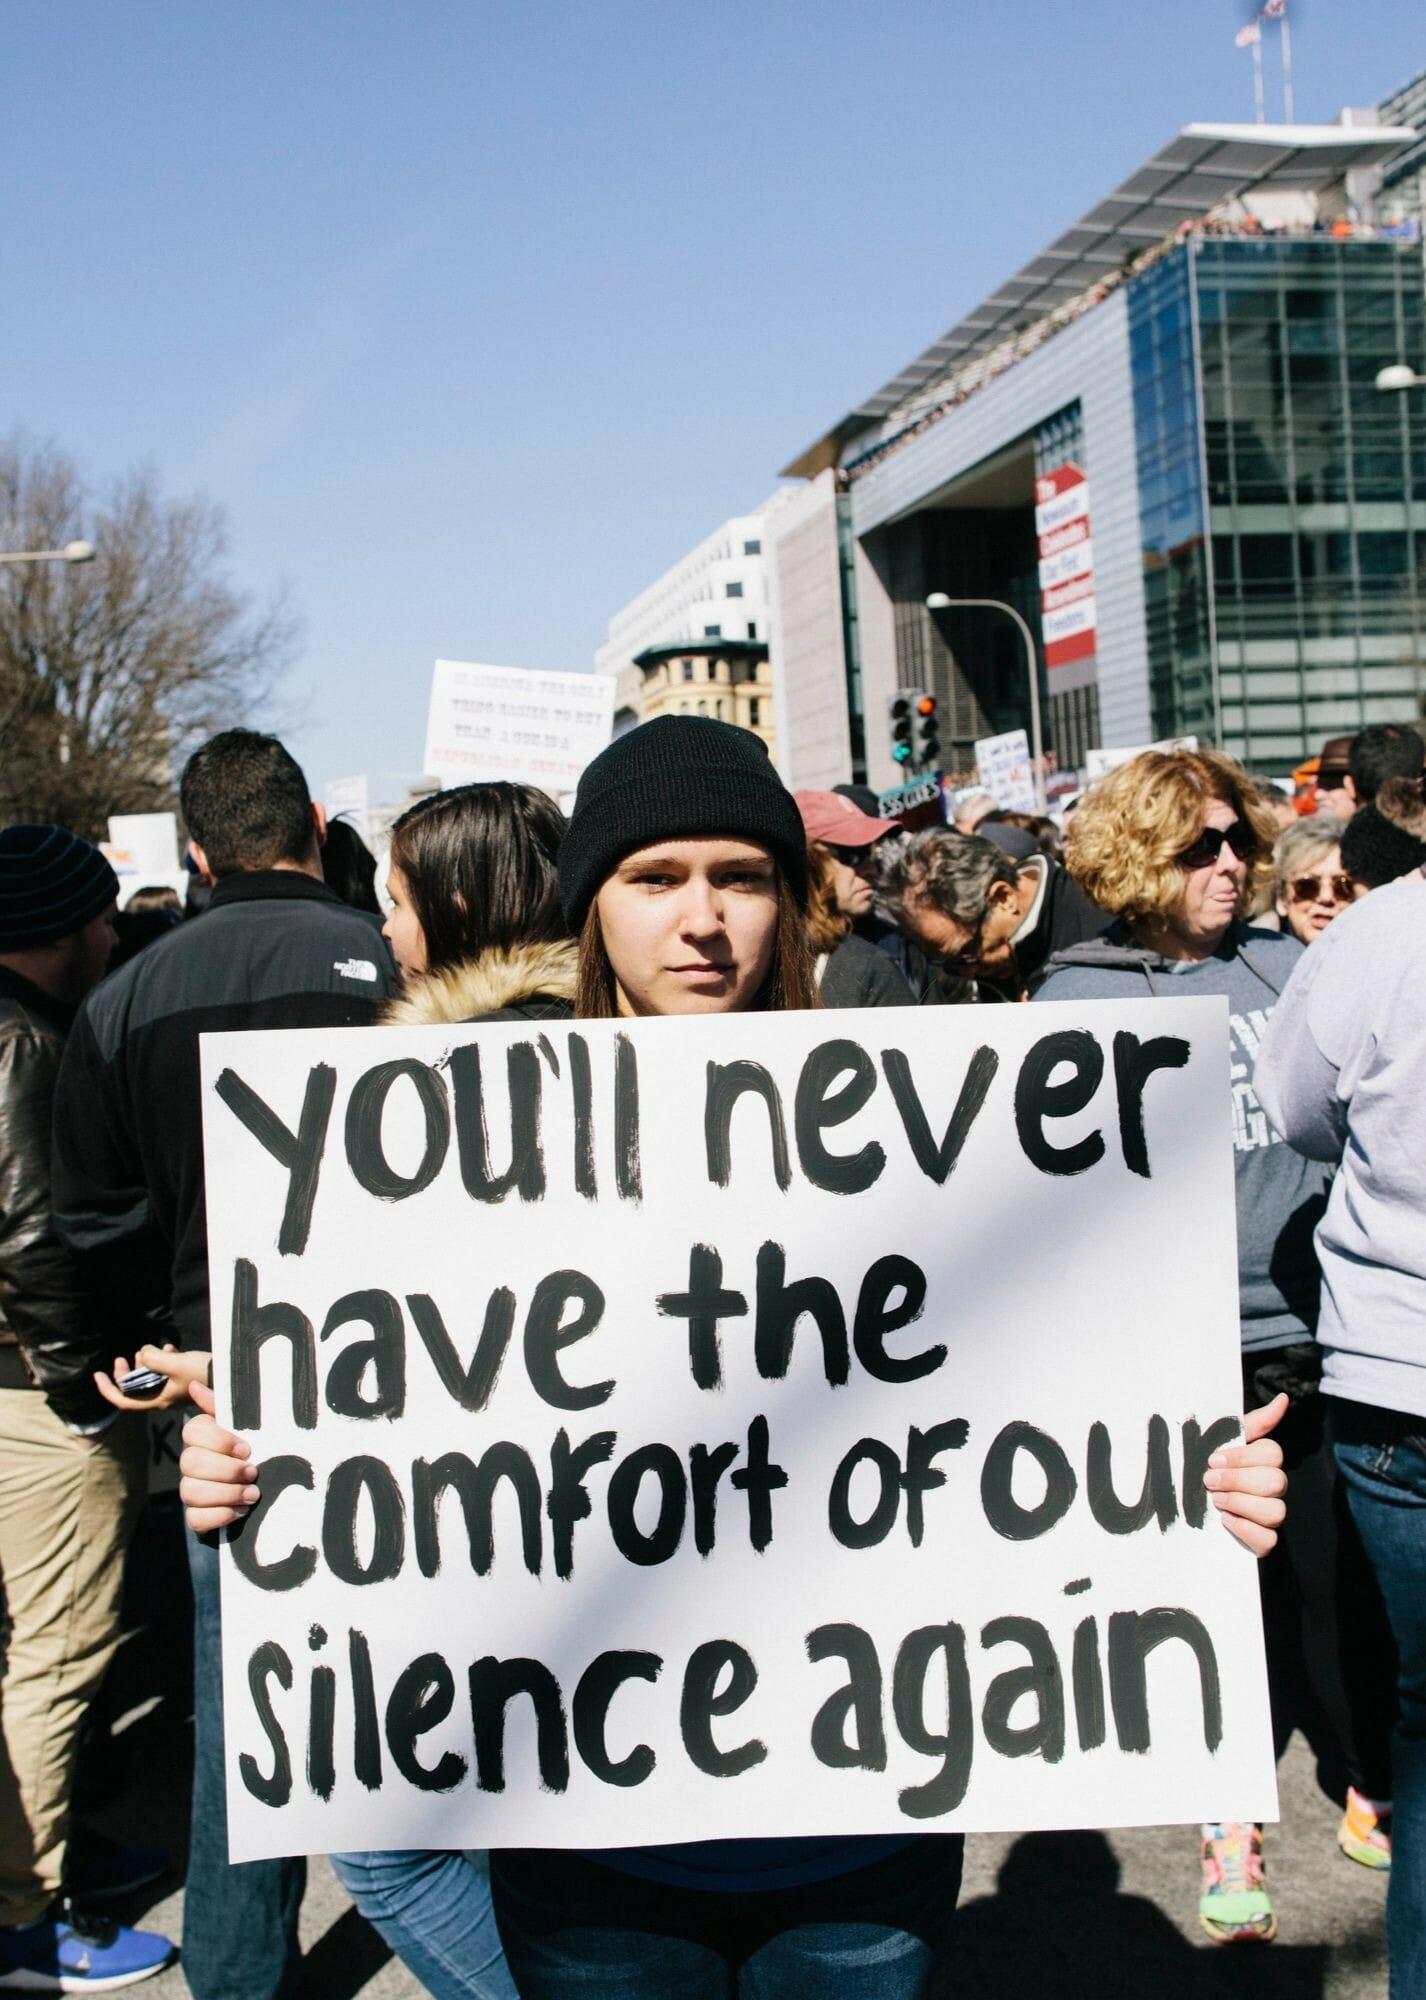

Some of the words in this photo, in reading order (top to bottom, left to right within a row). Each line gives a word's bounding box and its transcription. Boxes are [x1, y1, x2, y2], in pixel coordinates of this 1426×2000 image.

[214, 1031, 644, 1257] you'll
[705, 1027, 1191, 1197] never
[230, 1257, 616, 1431] have
[655, 1239, 949, 1391] the
[228, 1414, 788, 1592] comfort
[829, 1418, 970, 1549] of
[980, 1413, 1242, 1541] our
[238, 1622, 768, 1808] silence
[805, 1577, 1223, 1819] again
